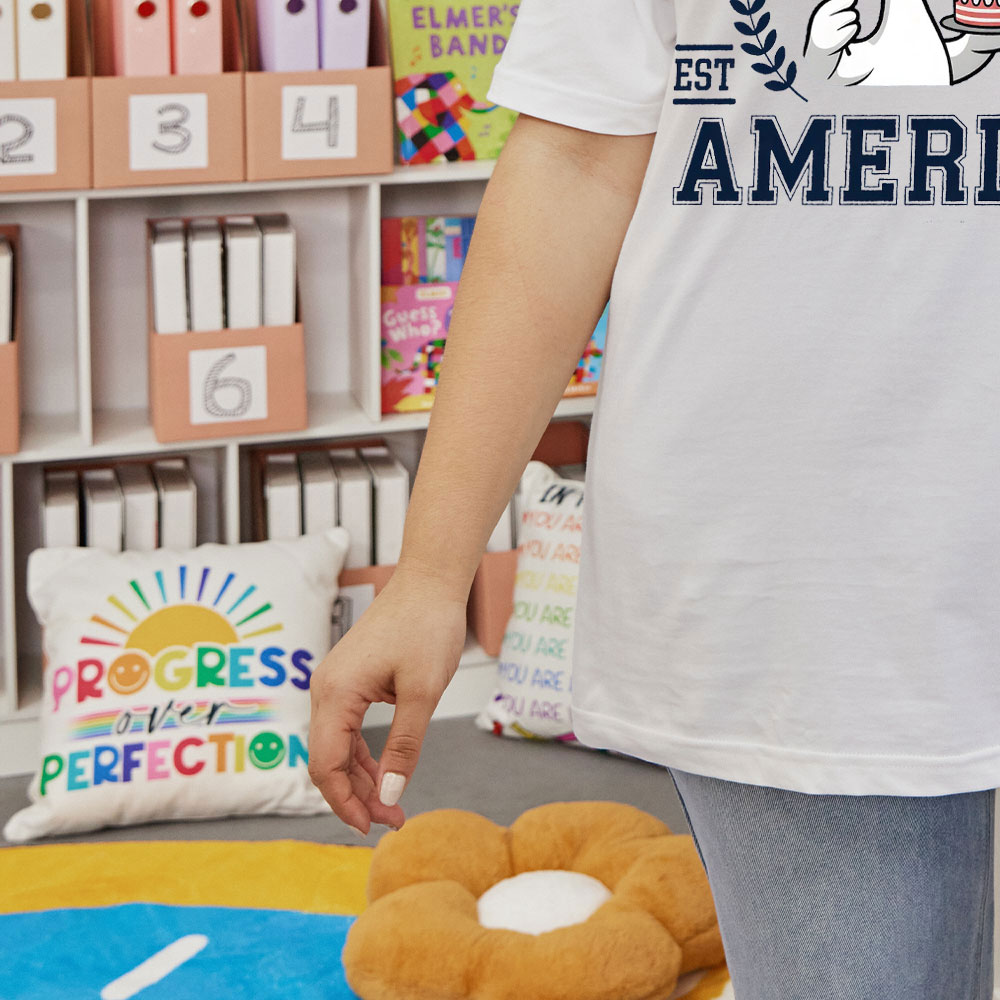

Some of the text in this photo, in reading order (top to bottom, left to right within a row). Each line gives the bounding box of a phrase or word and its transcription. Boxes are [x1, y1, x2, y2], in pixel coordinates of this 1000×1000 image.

[429, 34, 509, 59] BAND
[673, 58, 735, 91] EST
[0, 113, 34, 164] 2
[152, 103, 193, 155] 3
[291, 96, 340, 148] 4
[382, 306, 438, 328] Guess
[204, 353, 252, 419] 6
[52, 646, 314, 712] PROGRESS
[115, 700, 240, 734] over
[39, 731, 310, 796] PERFECTION
